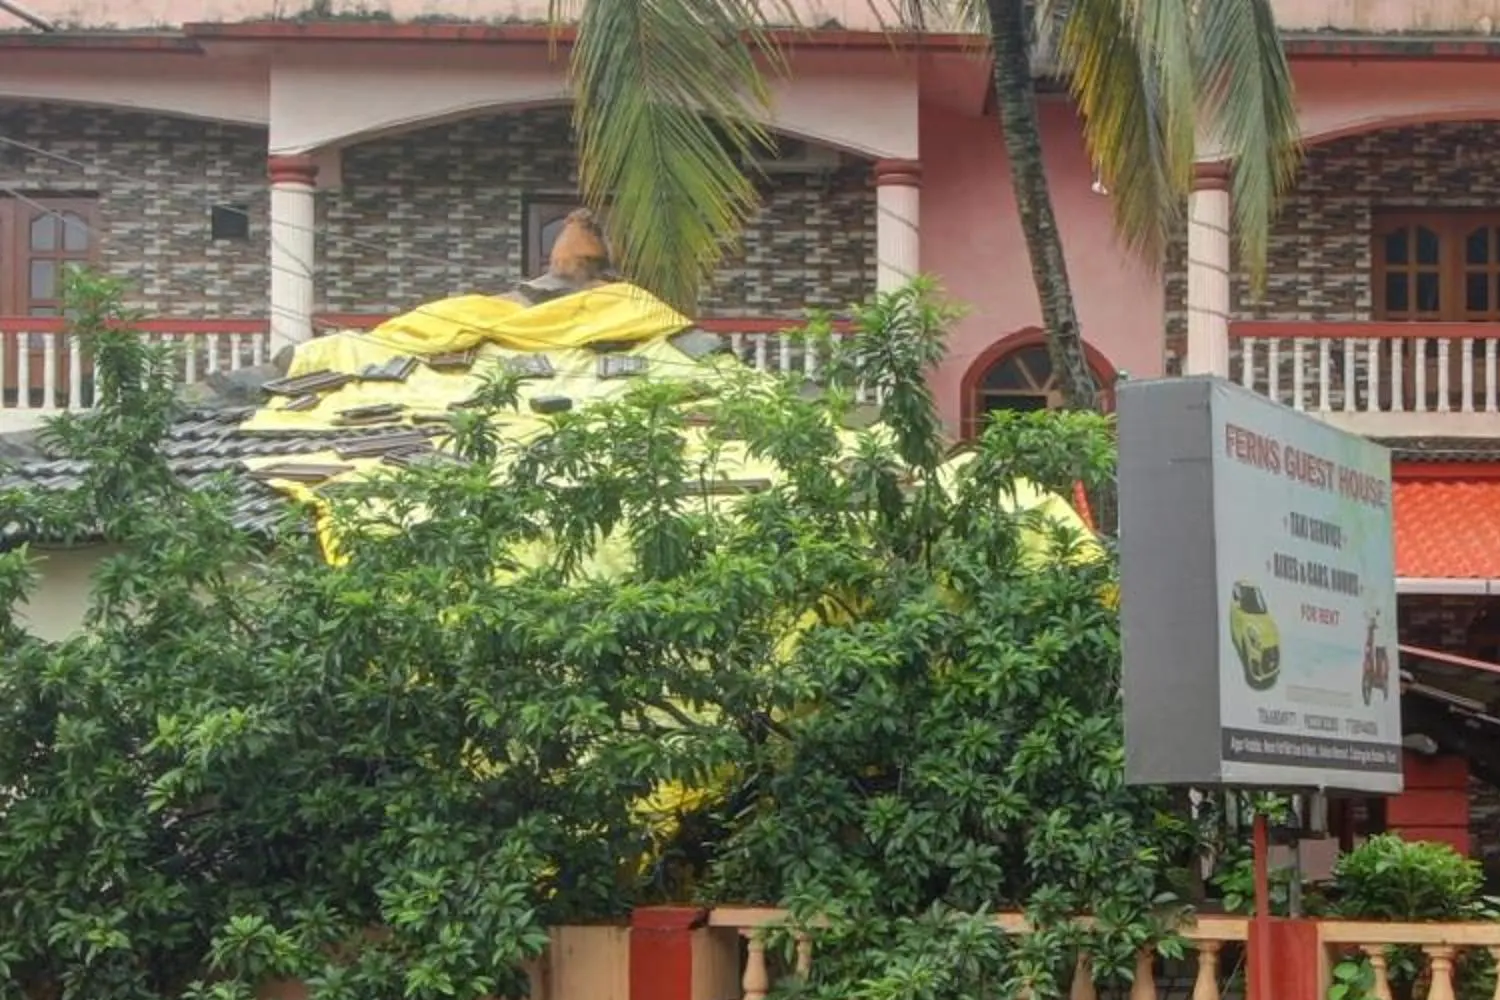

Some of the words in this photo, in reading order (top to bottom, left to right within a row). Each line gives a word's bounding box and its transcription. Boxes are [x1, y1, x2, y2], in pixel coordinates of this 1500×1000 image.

[1225, 423, 1281, 475] FERNS
[1284, 445, 1335, 491] GUEST
[1338, 465, 1387, 507] HOUSE
[1290, 511, 1309, 539] TAXI
[1309, 517, 1342, 548] SERVICE
[1300, 603, 1317, 624] FOR
[1318, 607, 1340, 626] RENT
